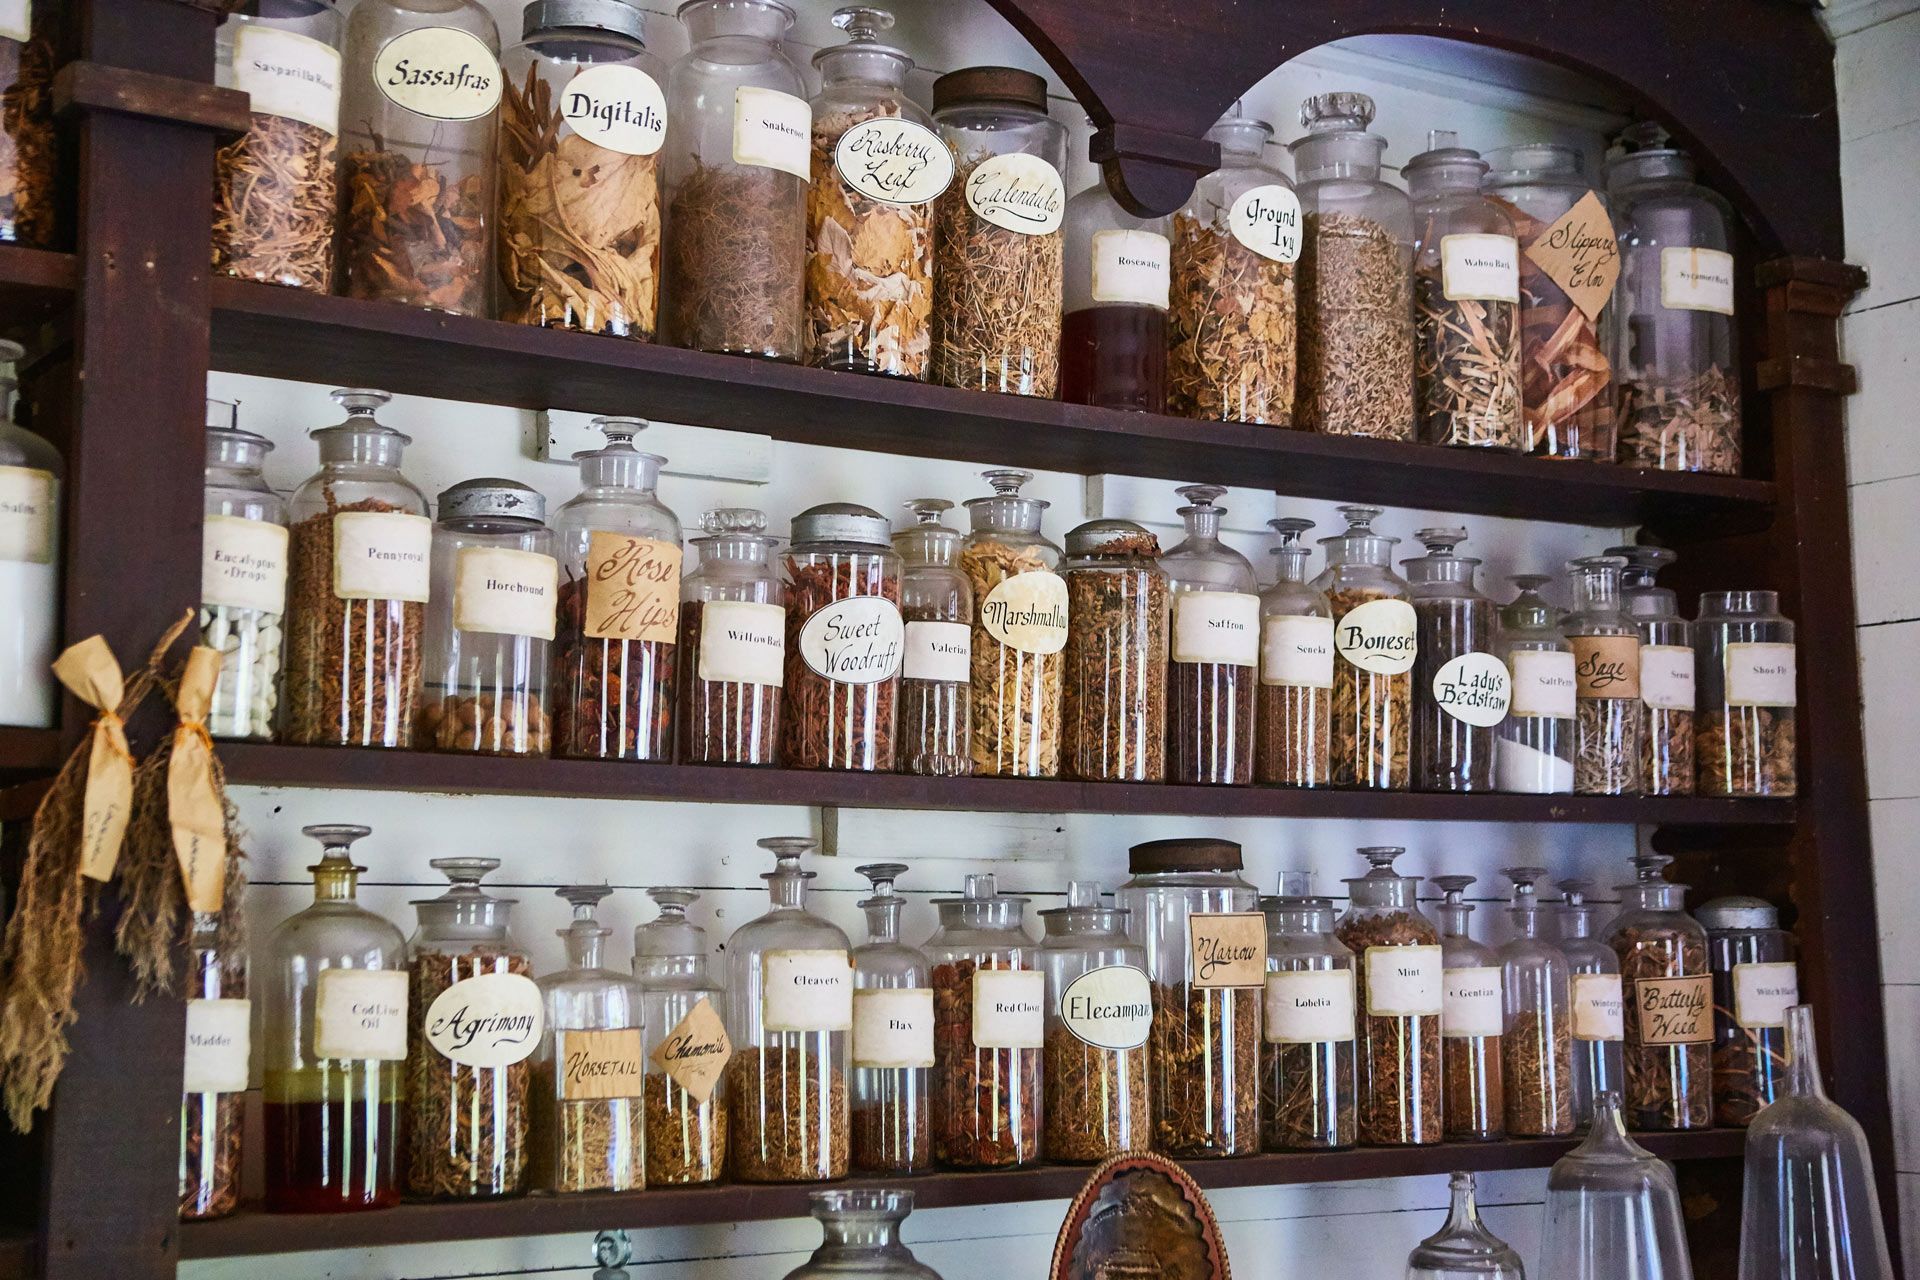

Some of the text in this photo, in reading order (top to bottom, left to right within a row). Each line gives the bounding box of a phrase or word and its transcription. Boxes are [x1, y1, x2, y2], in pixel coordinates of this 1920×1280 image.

[389, 60, 490, 94] Sassafras
[566, 93, 662, 133] Digitalis
[762, 119, 804, 141] Snakeroot
[1246, 199, 1295, 227] Ground
[1271, 225, 1295, 259] Ivy
[1118, 256, 1160, 271] Rosewater
[1569, 263, 1605, 289] Elm
[368, 547, 424, 564] Pennyroyal
[596, 540, 673, 586] Rose
[487, 579, 544, 597] Horchound
[597, 589, 676, 638] Hips
[1208, 618, 1244, 630] Saffron
[728, 630, 765, 644] Willow
[824, 614, 881, 641] Sweet
[1341, 626, 1415, 651] Boneset
[825, 641, 897, 674] Woodruff
[1577, 651, 1627, 689] Sage
[1459, 665, 1503, 697] Lady's
[1198, 937, 1256, 981] Yarrow
[794, 975, 839, 986] Cleavers
[1397, 968, 1420, 977] Mint
[996, 1003, 1015, 1013] Red
[1295, 997, 1331, 1008] Lobelia
[1643, 985, 1706, 1017] Butterfly
[432, 1005, 535, 1051] Agrimony
[889, 1019, 912, 1030] Flax
